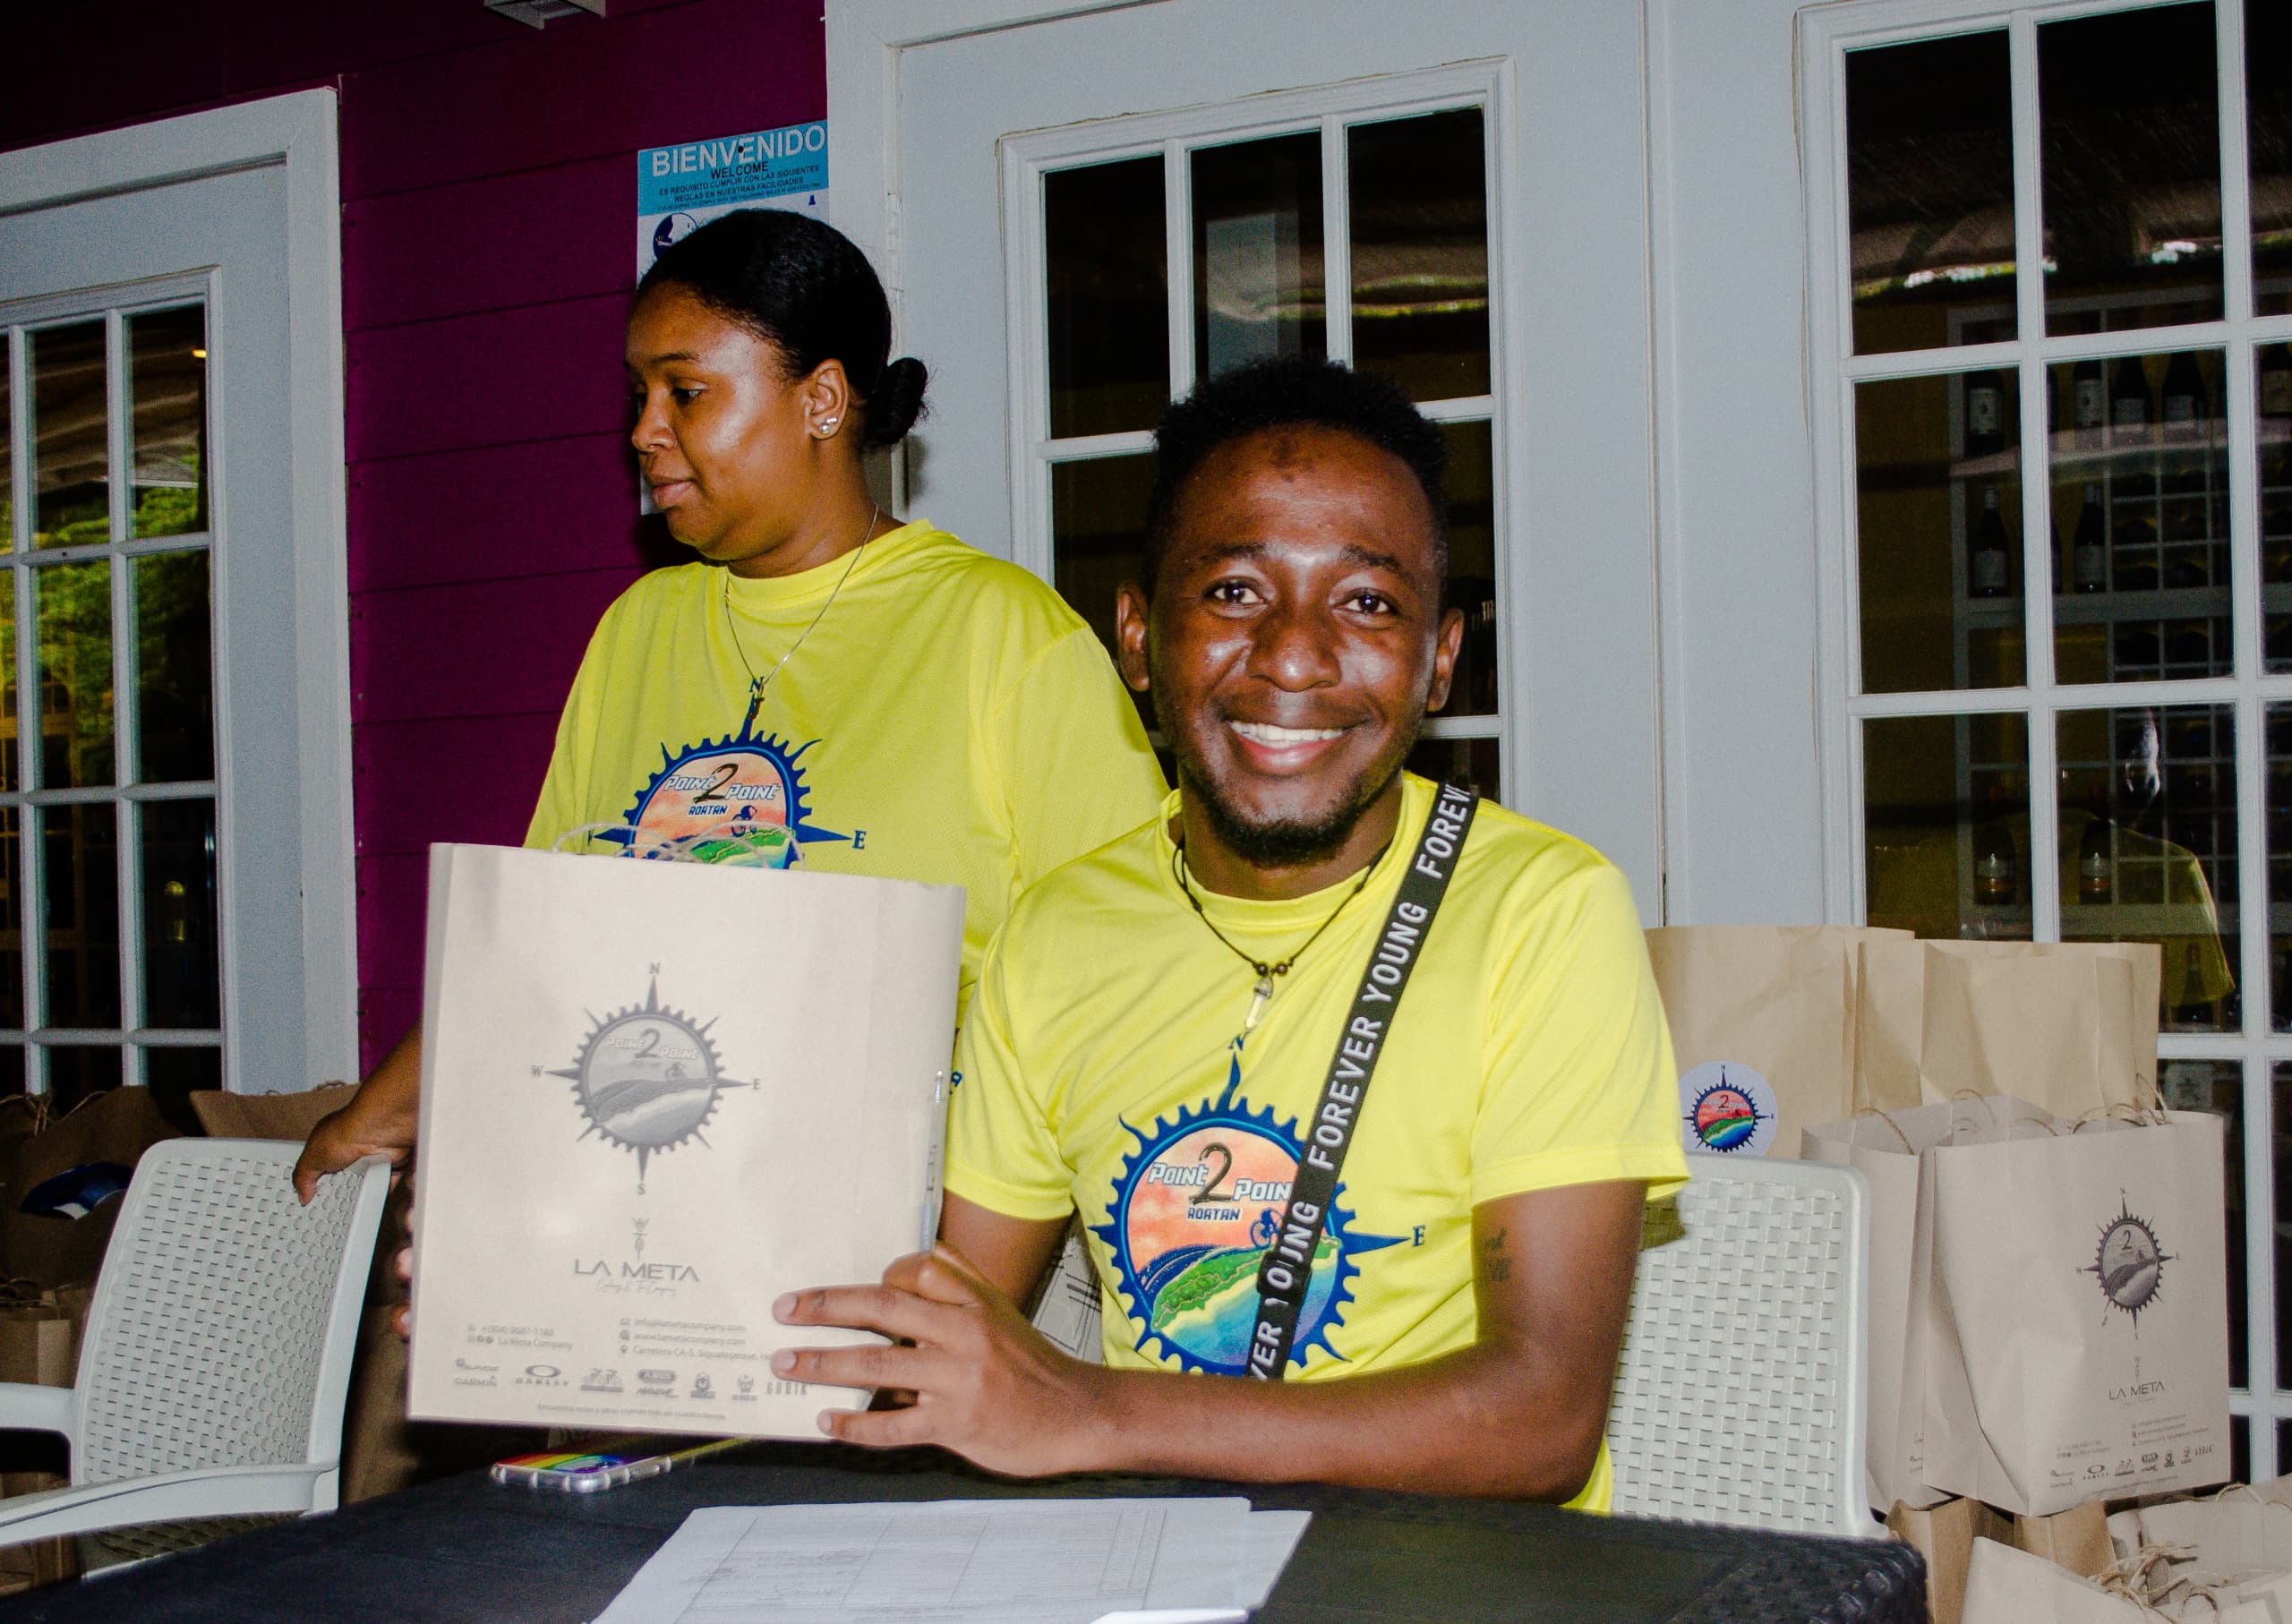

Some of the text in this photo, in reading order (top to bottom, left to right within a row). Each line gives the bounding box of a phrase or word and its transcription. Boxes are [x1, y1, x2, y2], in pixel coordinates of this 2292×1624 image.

[652, 125, 825, 177] BIENVENIDO
[671, 183, 709, 194] REQUISITO
[711, 178, 742, 188] CUMPLIR
[744, 175, 759, 184] CON
[761, 172, 775, 181] LAS
[776, 165, 819, 178] SIGUIENTES
[711, 161, 769, 179] WELCOME
[674, 192, 704, 203] REGLAS
[717, 184, 756, 196] NUESTRAS
[757, 177, 804, 190] FACILIDADES
[663, 763, 782, 804] POINT 2 POINT
[688, 805, 729, 816] ROATAN
[853, 830, 867, 850] E
[649, 962, 661, 974] N
[634, 1028, 661, 1059] 2
[1307, 902, 1429, 1170] FOREVER YOUNG
[531, 1065, 544, 1076] W
[753, 1079, 760, 1090] E
[1147, 1142, 1293, 1205] POINT 2 POIN
[637, 1183, 646, 1195] S
[1187, 1208, 1241, 1220] ROATAN
[1412, 1226, 1426, 1247] E
[2121, 1230, 2133, 1251] 2
[574, 1259, 700, 1282] LA META
[2108, 1380, 2165, 1401] LA META
